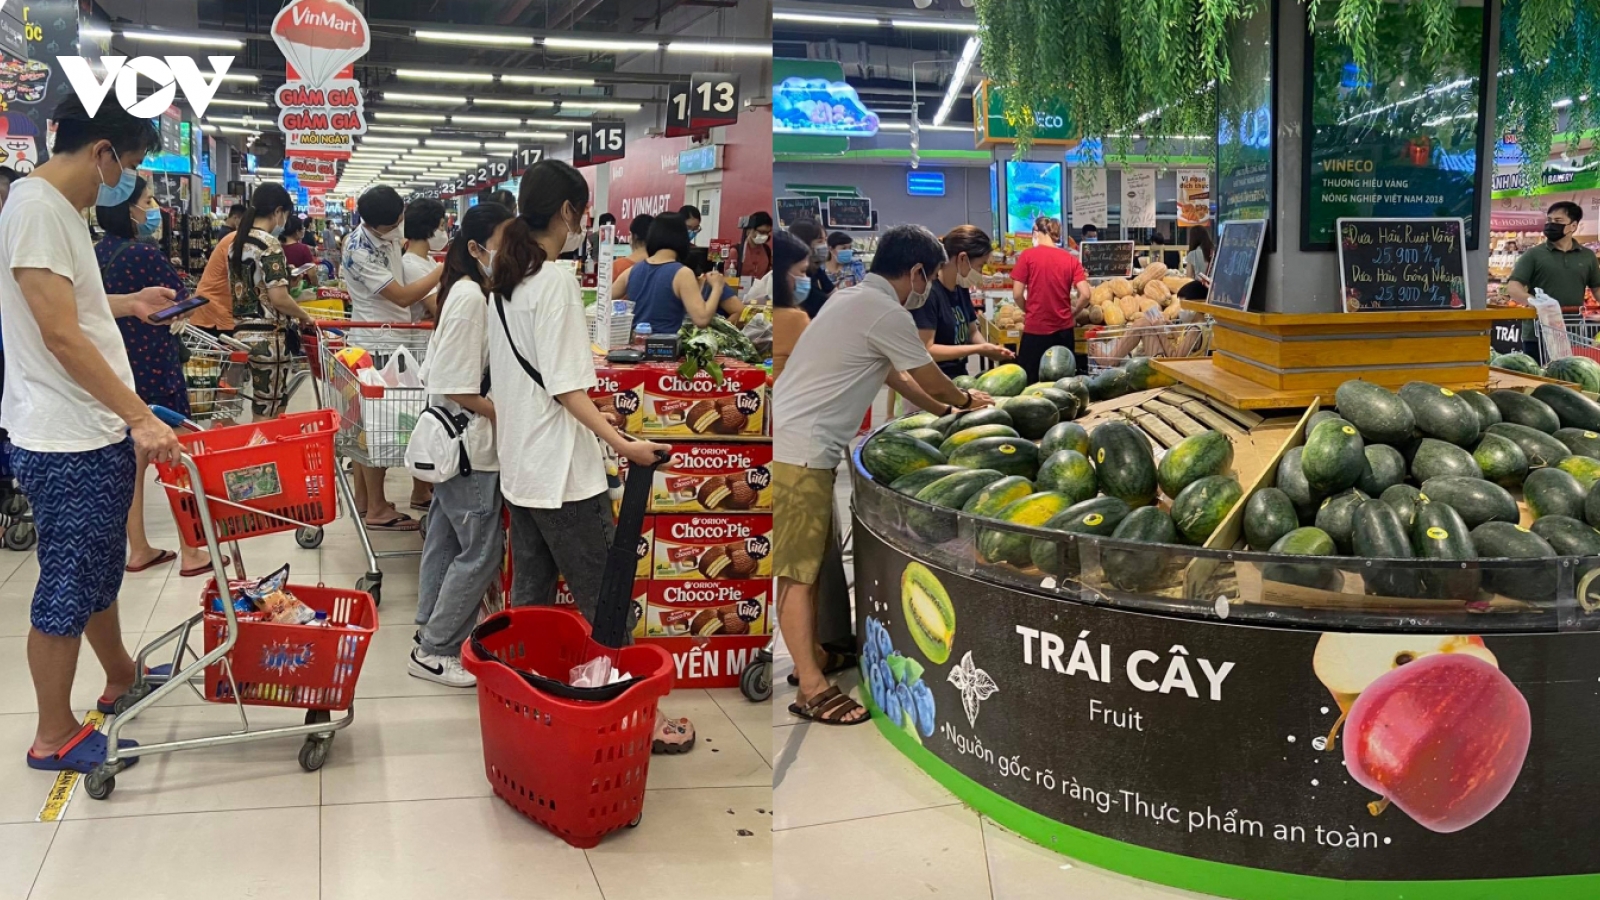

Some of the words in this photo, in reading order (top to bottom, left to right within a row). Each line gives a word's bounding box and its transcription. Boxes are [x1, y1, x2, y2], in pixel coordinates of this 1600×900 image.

[292, 5, 357, 34] VinMart
[280, 85, 324, 107] GIẢM
[328, 87, 358, 107] GIÁ
[697, 82, 734, 112] 13
[673, 93, 687, 120] 1
[283, 109, 328, 130] GIẢM
[331, 111, 361, 130] GIÁ
[577, 135, 587, 155] 1
[595, 129, 622, 150] 15
[521, 149, 542, 165] 17
[1322, 159, 1373, 172] VINECO
[478, 168, 487, 181] 2
[489, 163, 507, 176] 19
[1548, 172, 1574, 184] BAKERY
[442, 183, 456, 194] 23
[467, 174, 476, 186] 2
[1322, 177, 1360, 188] THƯƠNG
[1362, 178, 1383, 190] HIỆU
[1385, 178, 1409, 188] VÀNG
[631, 194, 670, 217] VINMART
[1321, 193, 1348, 203] NÔNG
[1350, 194, 1382, 205] NGHIỆP
[1383, 193, 1402, 206] VIỆT
[1403, 194, 1423, 203] NAM
[1425, 194, 1444, 204] 2018
[1496, 325, 1519, 343] TRÁI
[700, 447, 727, 455] ORION
[1016, 624, 1112, 684] TRÁI
[1126, 645, 1235, 702] CÂY
[1089, 699, 1144, 732] Fruit
[945, 722, 994, 765] Nguồn
[998, 750, 1032, 784] gốc
[1035, 765, 1057, 791] rõ
[1187, 806, 1264, 839] phẩm
[1273, 822, 1306, 843] an
[1315, 823, 1379, 850] toàn
